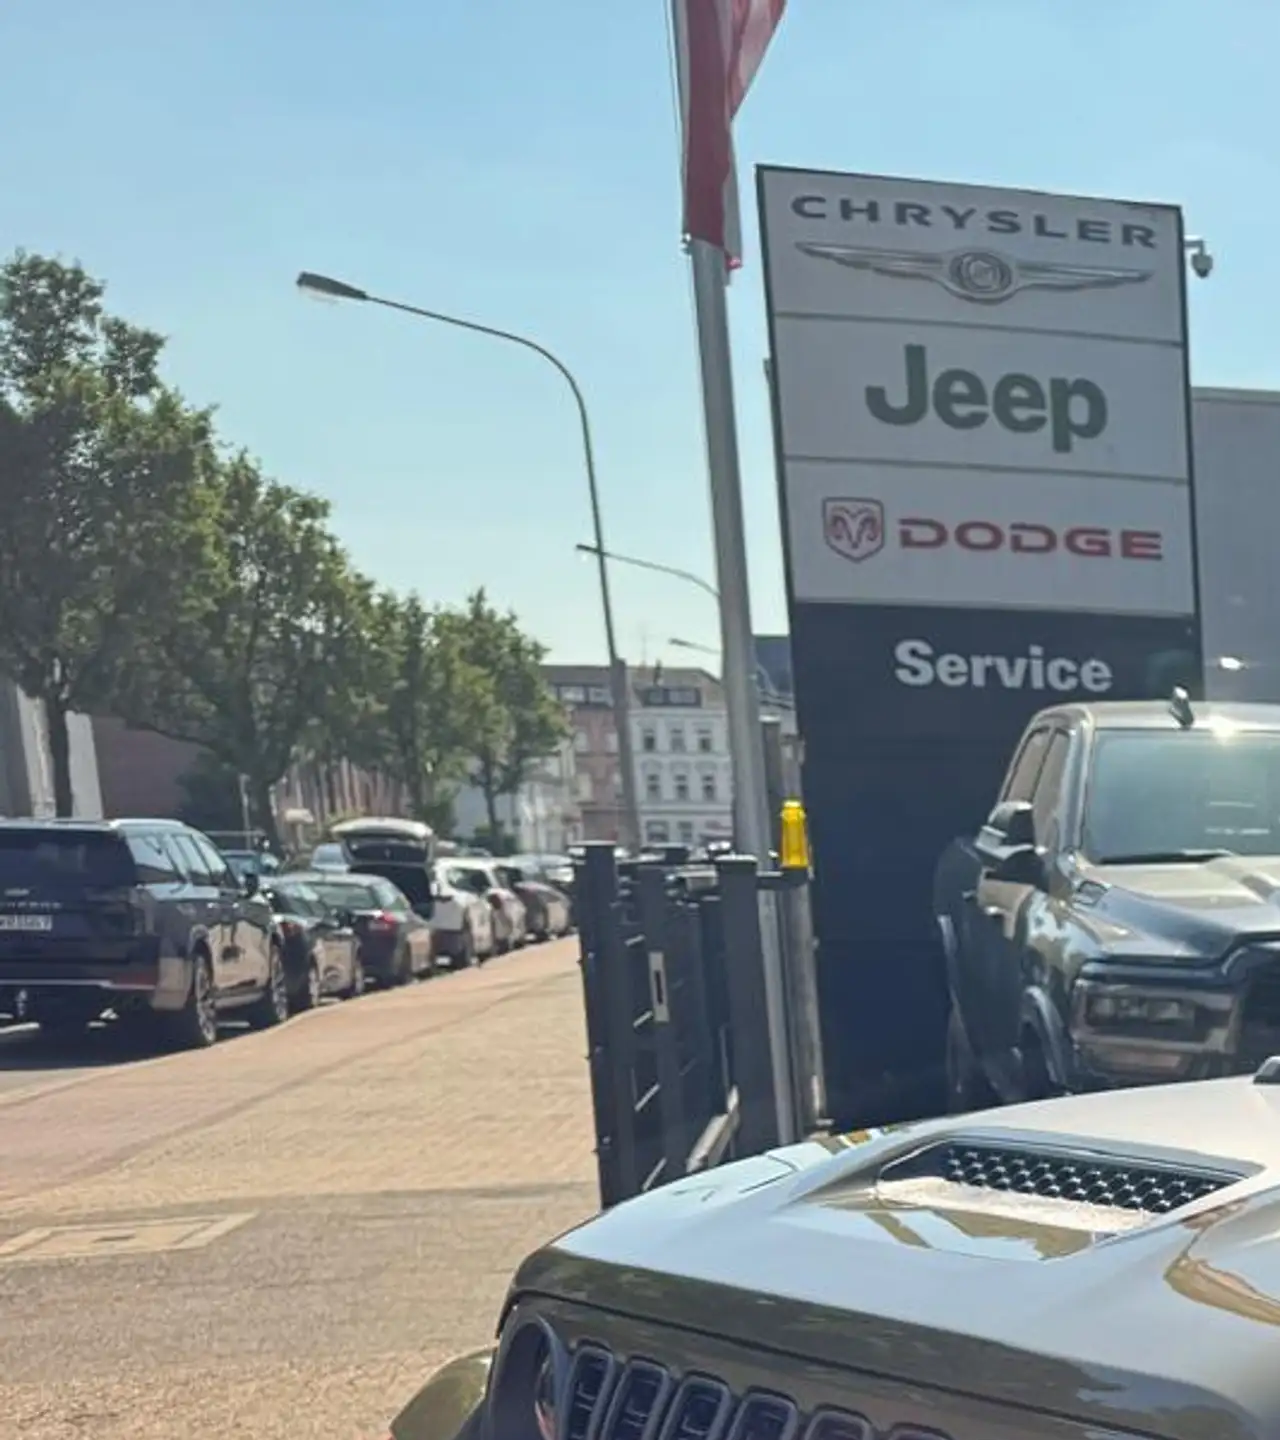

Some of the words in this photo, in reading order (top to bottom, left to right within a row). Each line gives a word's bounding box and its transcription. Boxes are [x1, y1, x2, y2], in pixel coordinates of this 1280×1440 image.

[791, 196, 1159, 249] CHRYSLER
[865, 344, 1109, 453] Jeep
[897, 517, 1164, 561] DODGE
[893, 639, 1113, 692] Service
